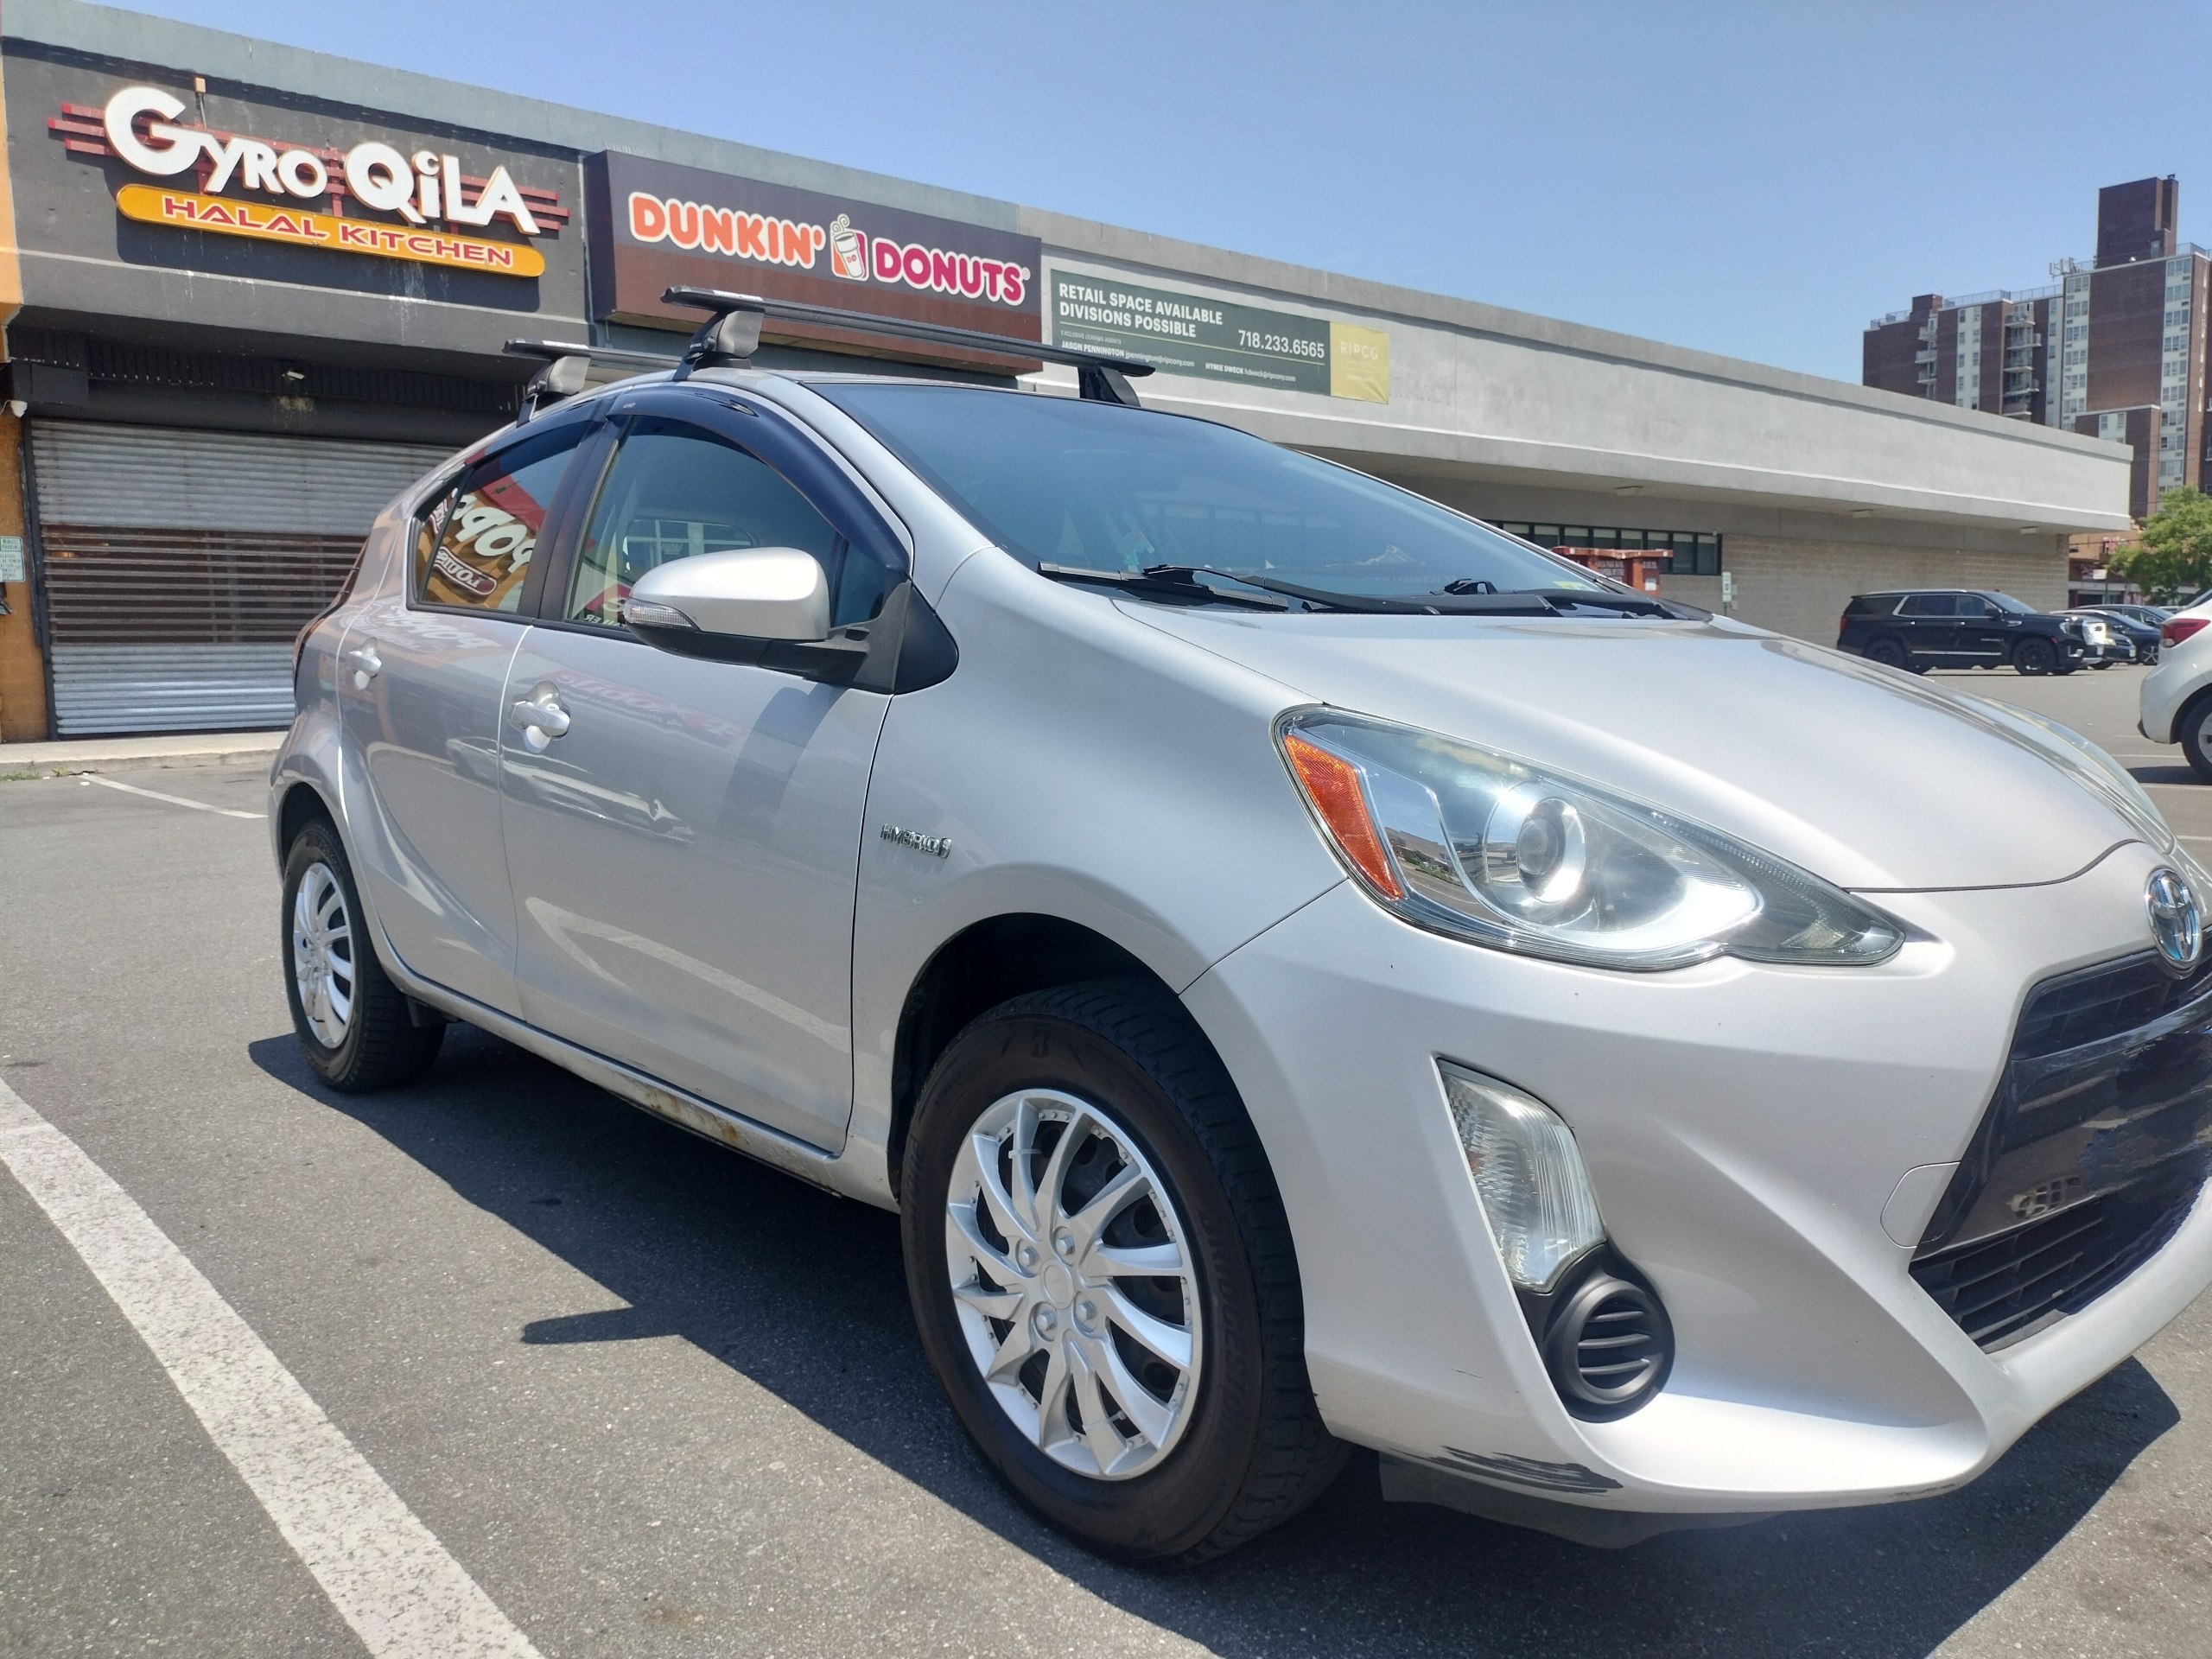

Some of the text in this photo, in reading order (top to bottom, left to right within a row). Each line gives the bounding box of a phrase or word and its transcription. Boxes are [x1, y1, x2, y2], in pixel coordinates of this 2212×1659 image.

[162, 195, 513, 268] HALAL KITCHEN
[629, 192, 1027, 306] DUNKIN' DONUTS
[1058, 283, 1223, 326] RETAIL SPACE AVAILABLE
[1059, 301, 1196, 338] DIVISIONS POSSIBLE
[1062, 340, 1084, 352] JASON
[1084, 344, 1124, 358] PENNINGTON
[1238, 329, 1325, 359] 718.233.6565
[1340, 341, 1379, 360] RIPCO
